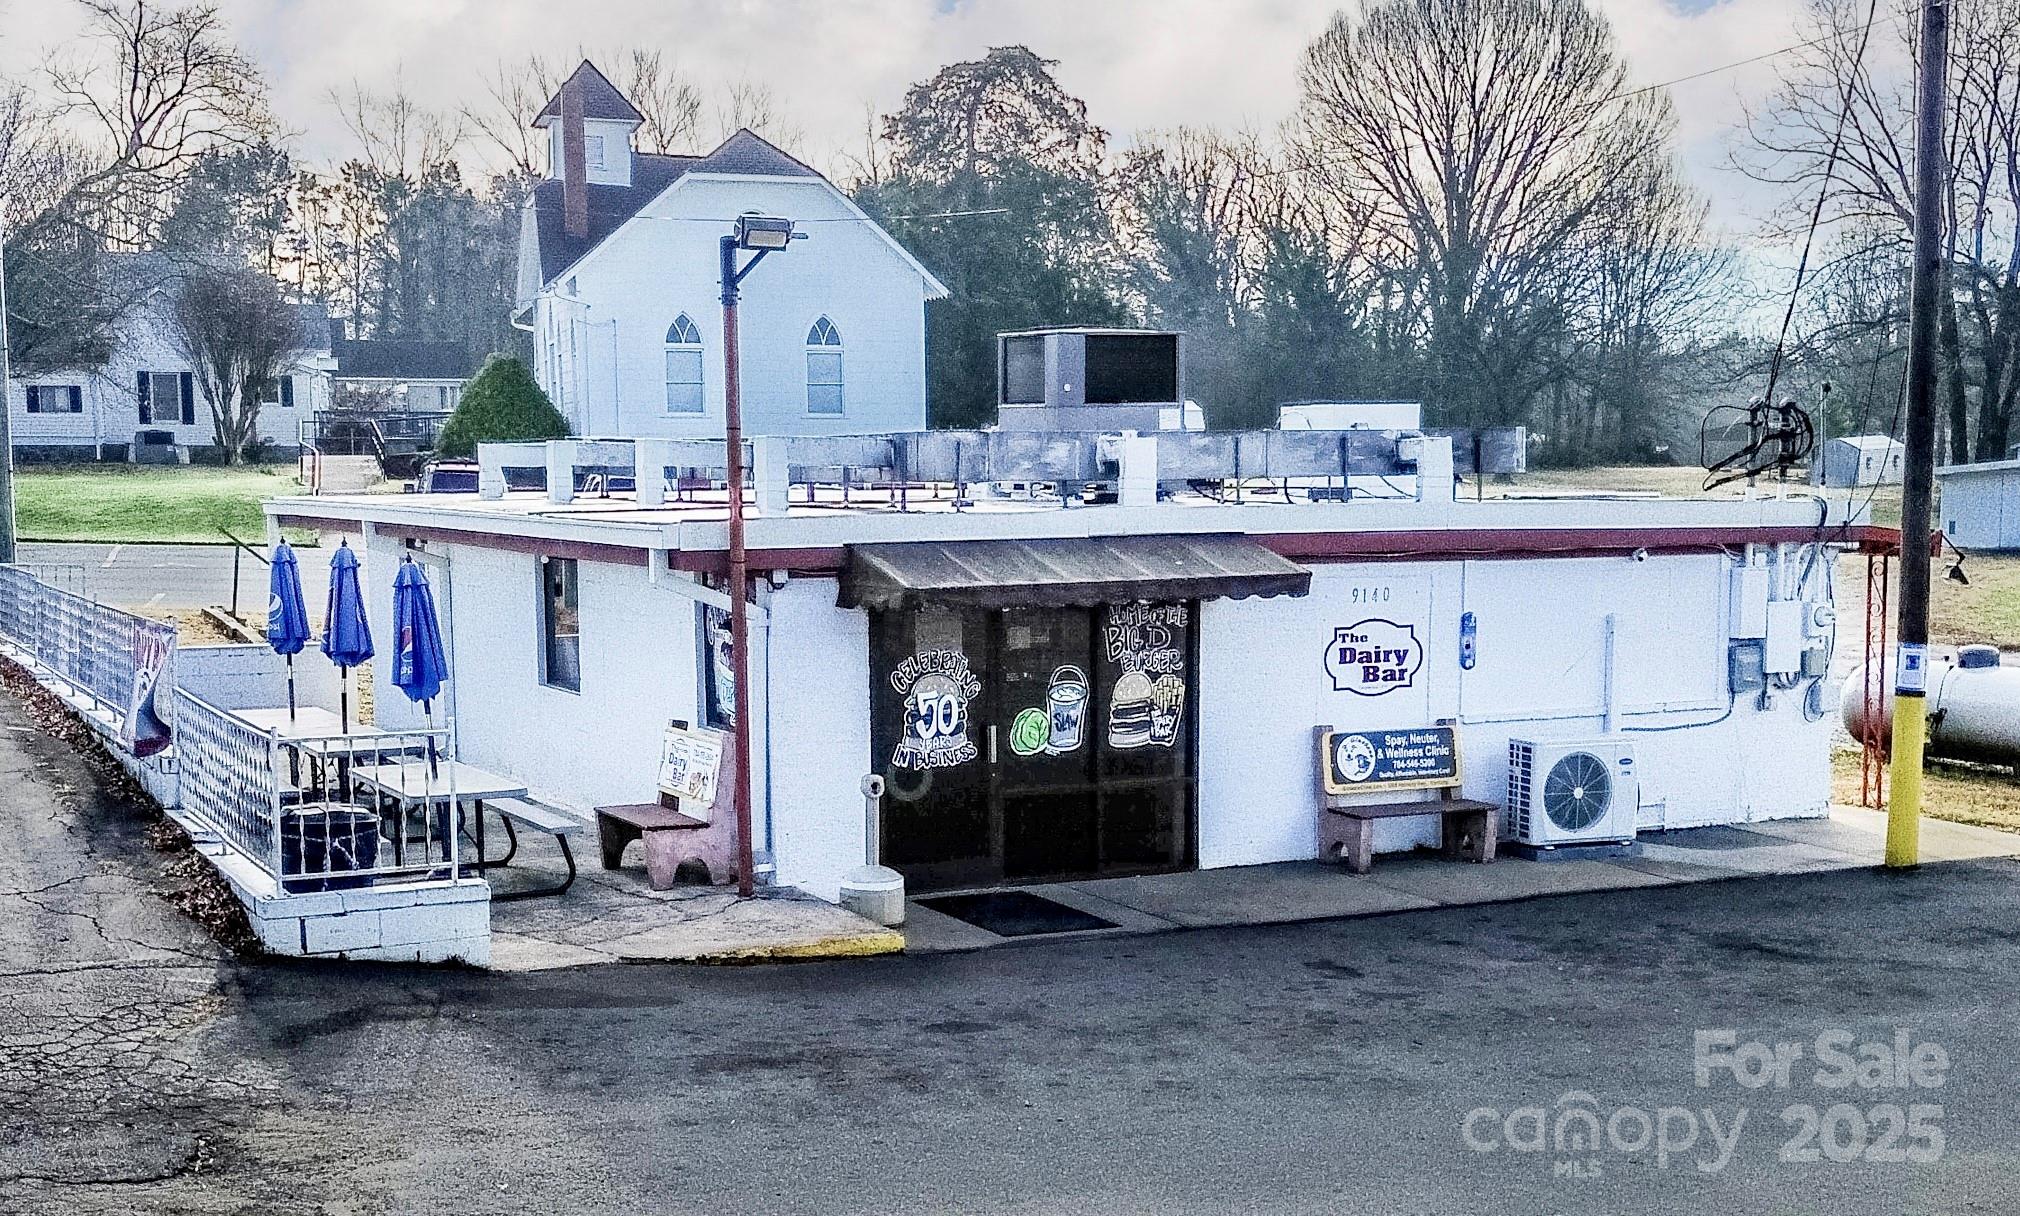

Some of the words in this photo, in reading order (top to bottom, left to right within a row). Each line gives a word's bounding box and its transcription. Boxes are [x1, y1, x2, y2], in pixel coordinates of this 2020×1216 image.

[1352, 587, 1390, 604] 9140
[1109, 603, 1150, 626] HOME
[1103, 624, 1143, 662] BIG
[1146, 625, 1171, 649] D
[1338, 632, 1368, 643] The
[1338, 645, 1409, 667] Dairy
[1362, 665, 1408, 683] Bar
[915, 690, 959, 740] 50
[1053, 711, 1079, 732] SLAW
[1384, 734, 1408, 748] Spay,
[1410, 732, 1440, 745] Neuter,
[891, 743, 916, 768] IN
[1377, 748, 1384, 759] &
[1385, 747, 1423, 759] Wellness
[1425, 744, 1450, 757] Clinic
